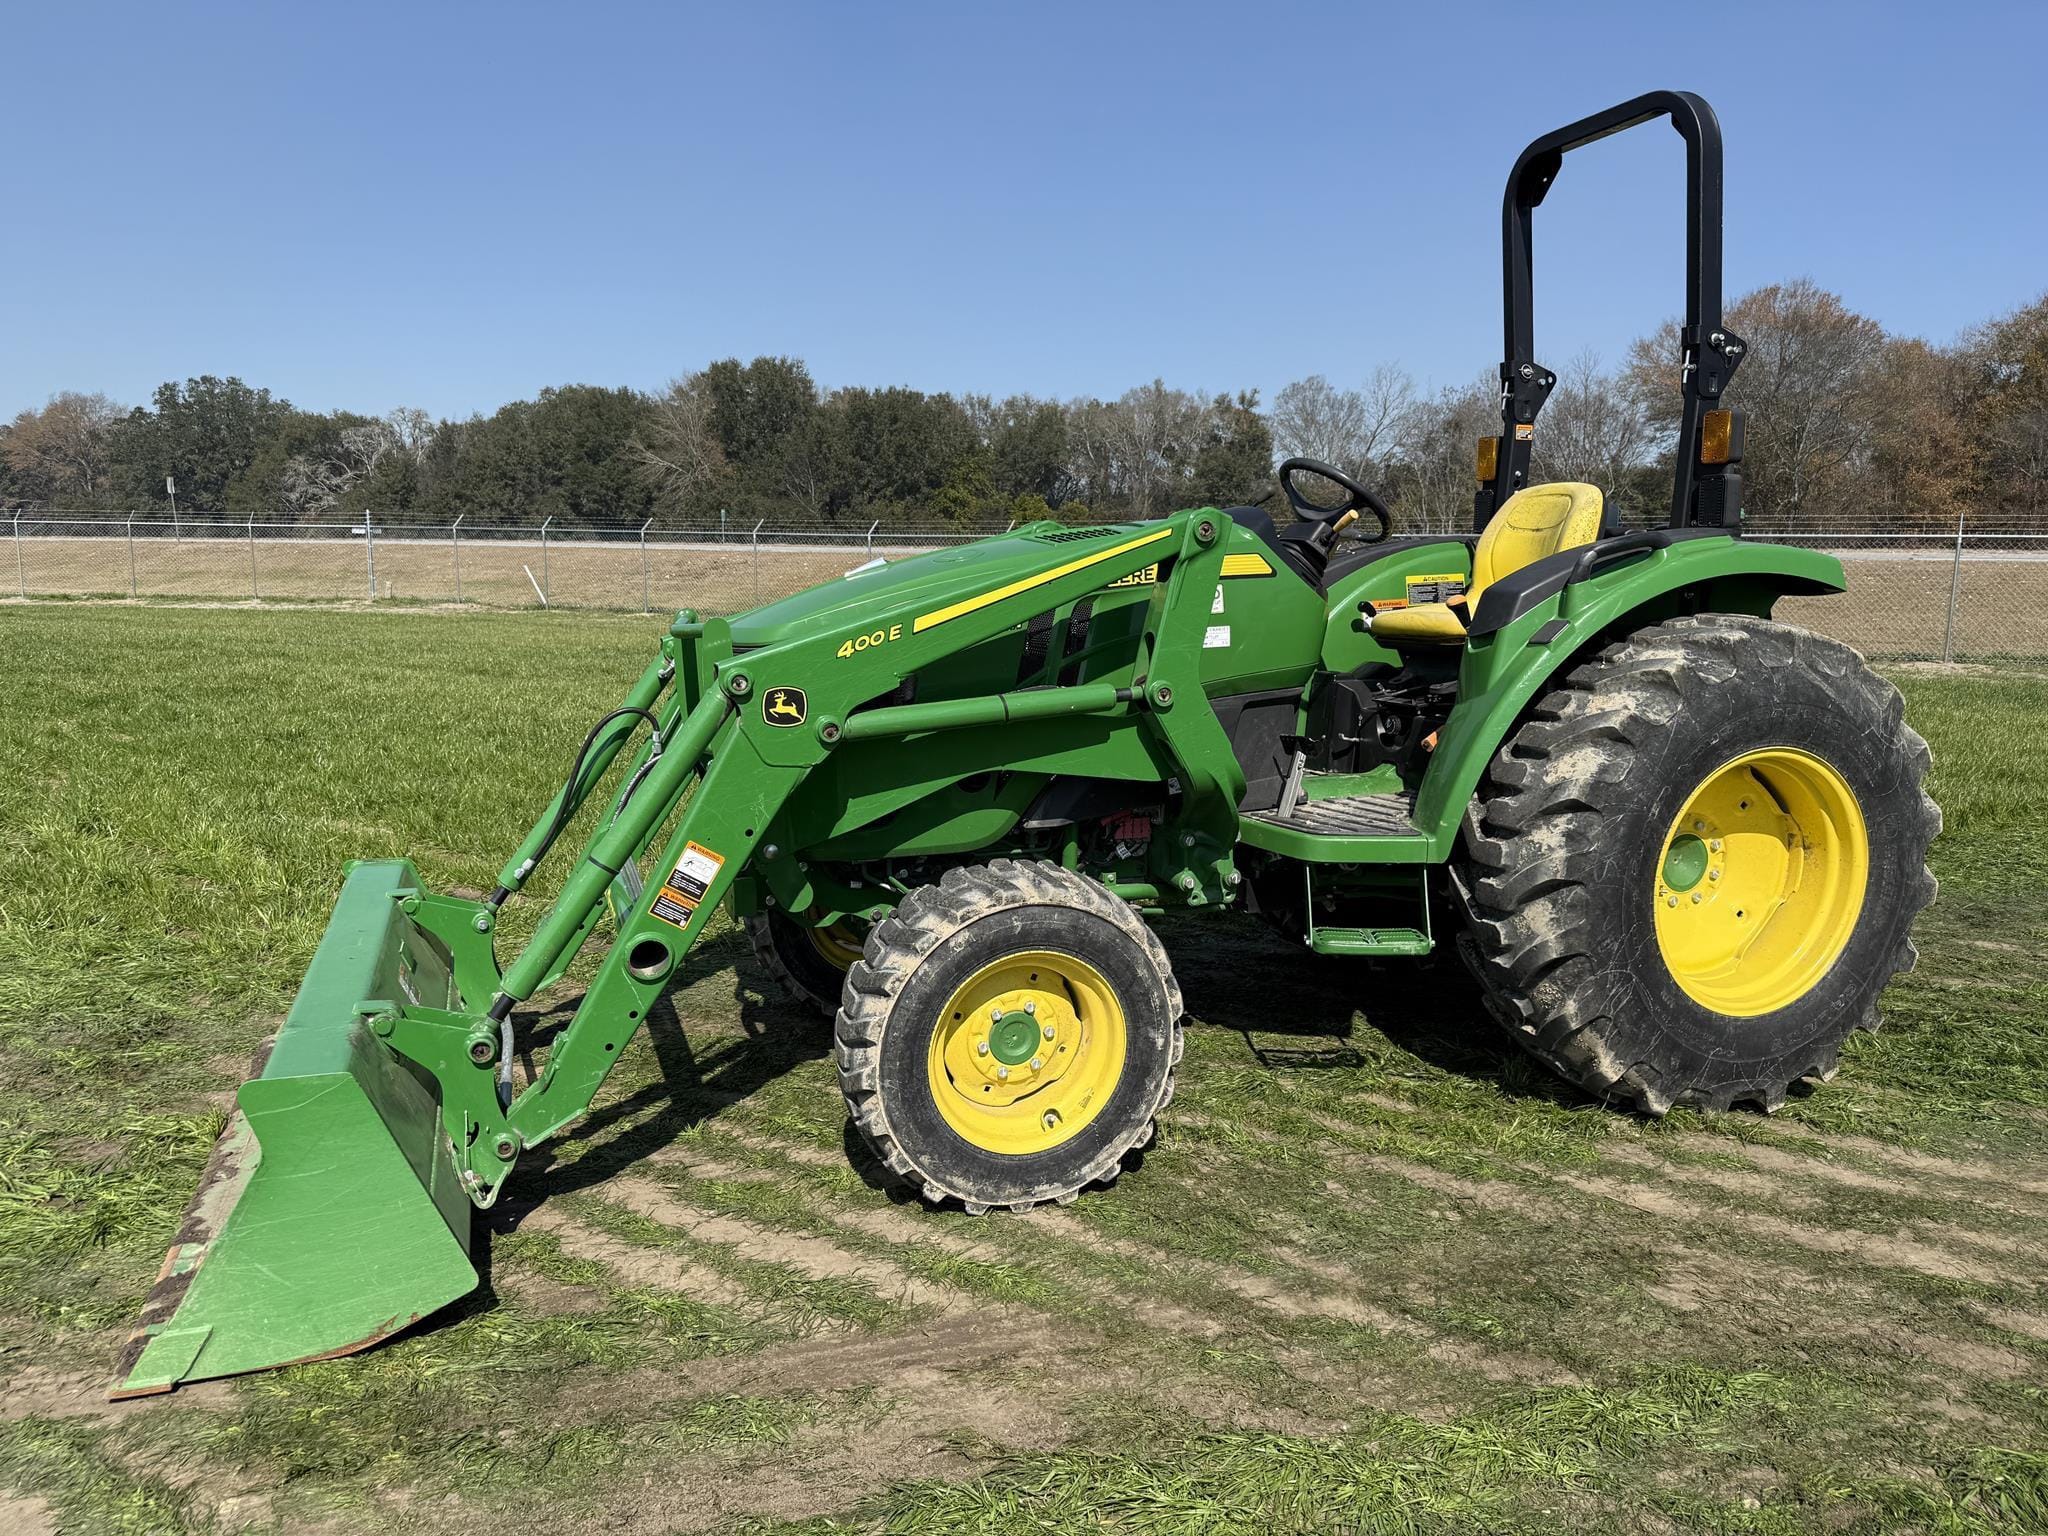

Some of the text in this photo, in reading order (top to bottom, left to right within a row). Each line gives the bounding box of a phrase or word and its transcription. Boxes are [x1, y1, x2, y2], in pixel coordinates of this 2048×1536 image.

[836, 622, 904, 659] 400 E
[697, 845, 721, 862] WARNING
